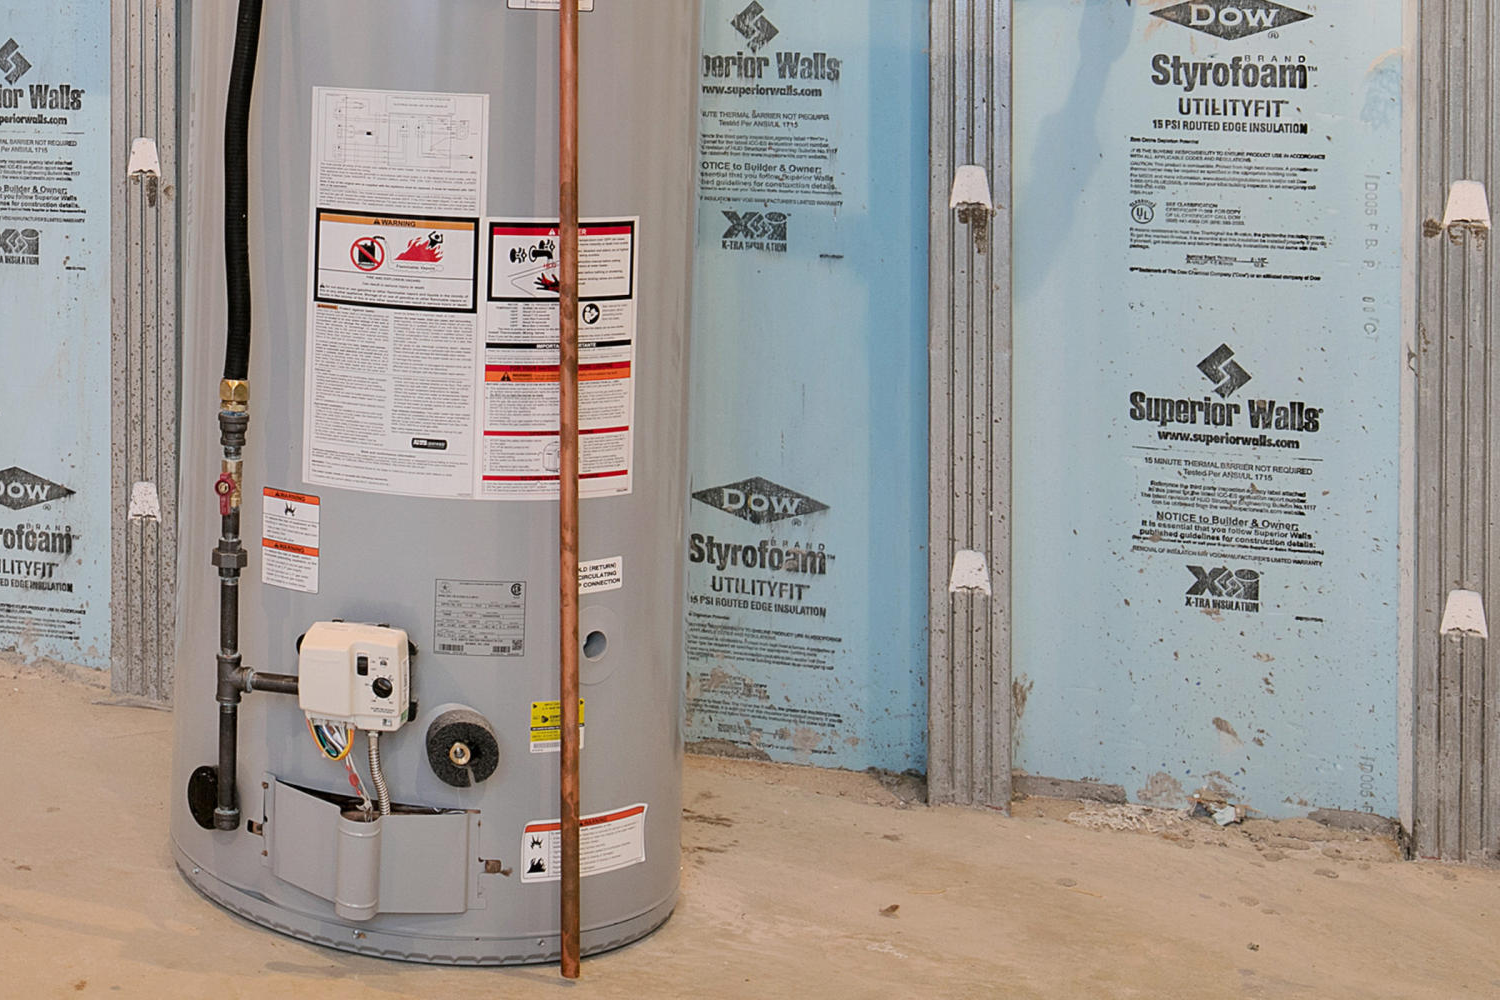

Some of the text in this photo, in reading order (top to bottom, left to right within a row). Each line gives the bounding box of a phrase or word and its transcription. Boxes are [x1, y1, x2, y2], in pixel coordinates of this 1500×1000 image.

[1188, 2, 1280, 28] DOW
[776, 52, 840, 81] Walls
[1244, 54, 1306, 63] BRAND
[1152, 120, 1308, 134] 15 PSI ROUTED EDGE INSULATION
[1129, 391, 1321, 433] Superior Walls
[1157, 429, 1300, 450] www.superiorwalls.com
[1255, 464, 1272, 472] NOT
[1272, 465, 1313, 476] REQUIRED
[722, 488, 801, 515] DOW
[1156, 510, 1197, 523] NOTICE
[1199, 514, 1210, 524] to
[1212, 515, 1249, 528] Builder
[1251, 518, 1260, 528] &
[715, 597, 749, 610] ROUTED
[750, 600, 773, 613] EDGE
[774, 602, 827, 618] INSULATION
